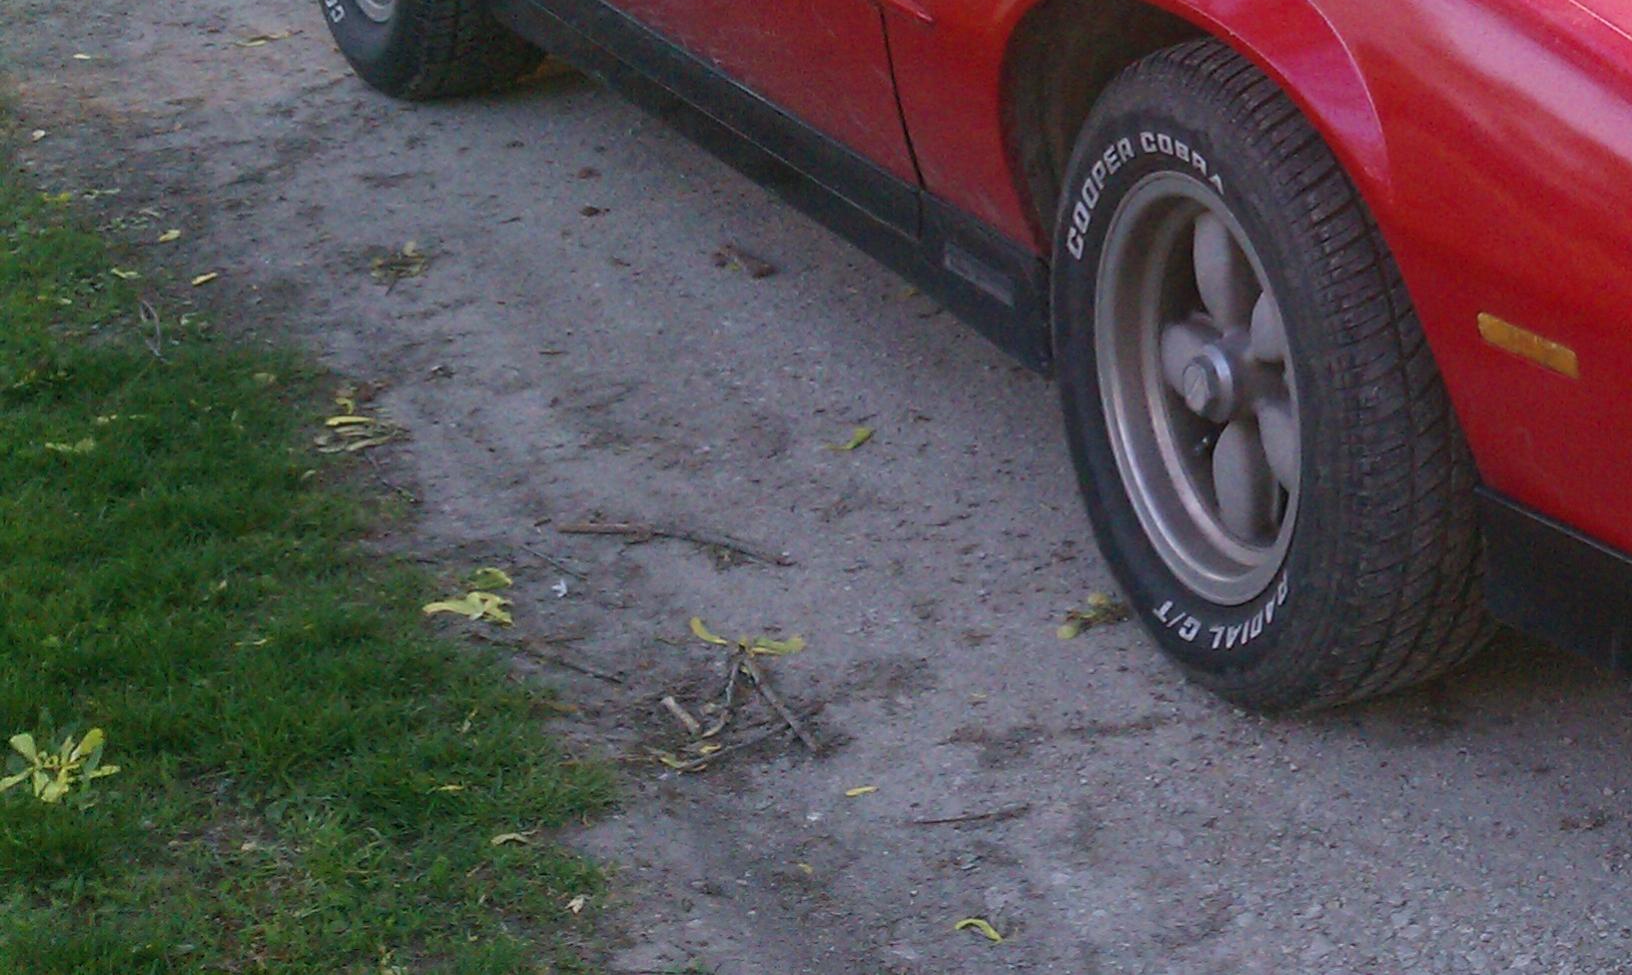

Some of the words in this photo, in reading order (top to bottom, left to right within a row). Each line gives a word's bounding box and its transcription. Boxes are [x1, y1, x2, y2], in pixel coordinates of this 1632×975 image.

[1066, 127, 1136, 260] COOPER
[1140, 131, 1224, 196] COBRA
[1152, 600, 1201, 642] G/T
[1209, 569, 1288, 649] RADIAL
